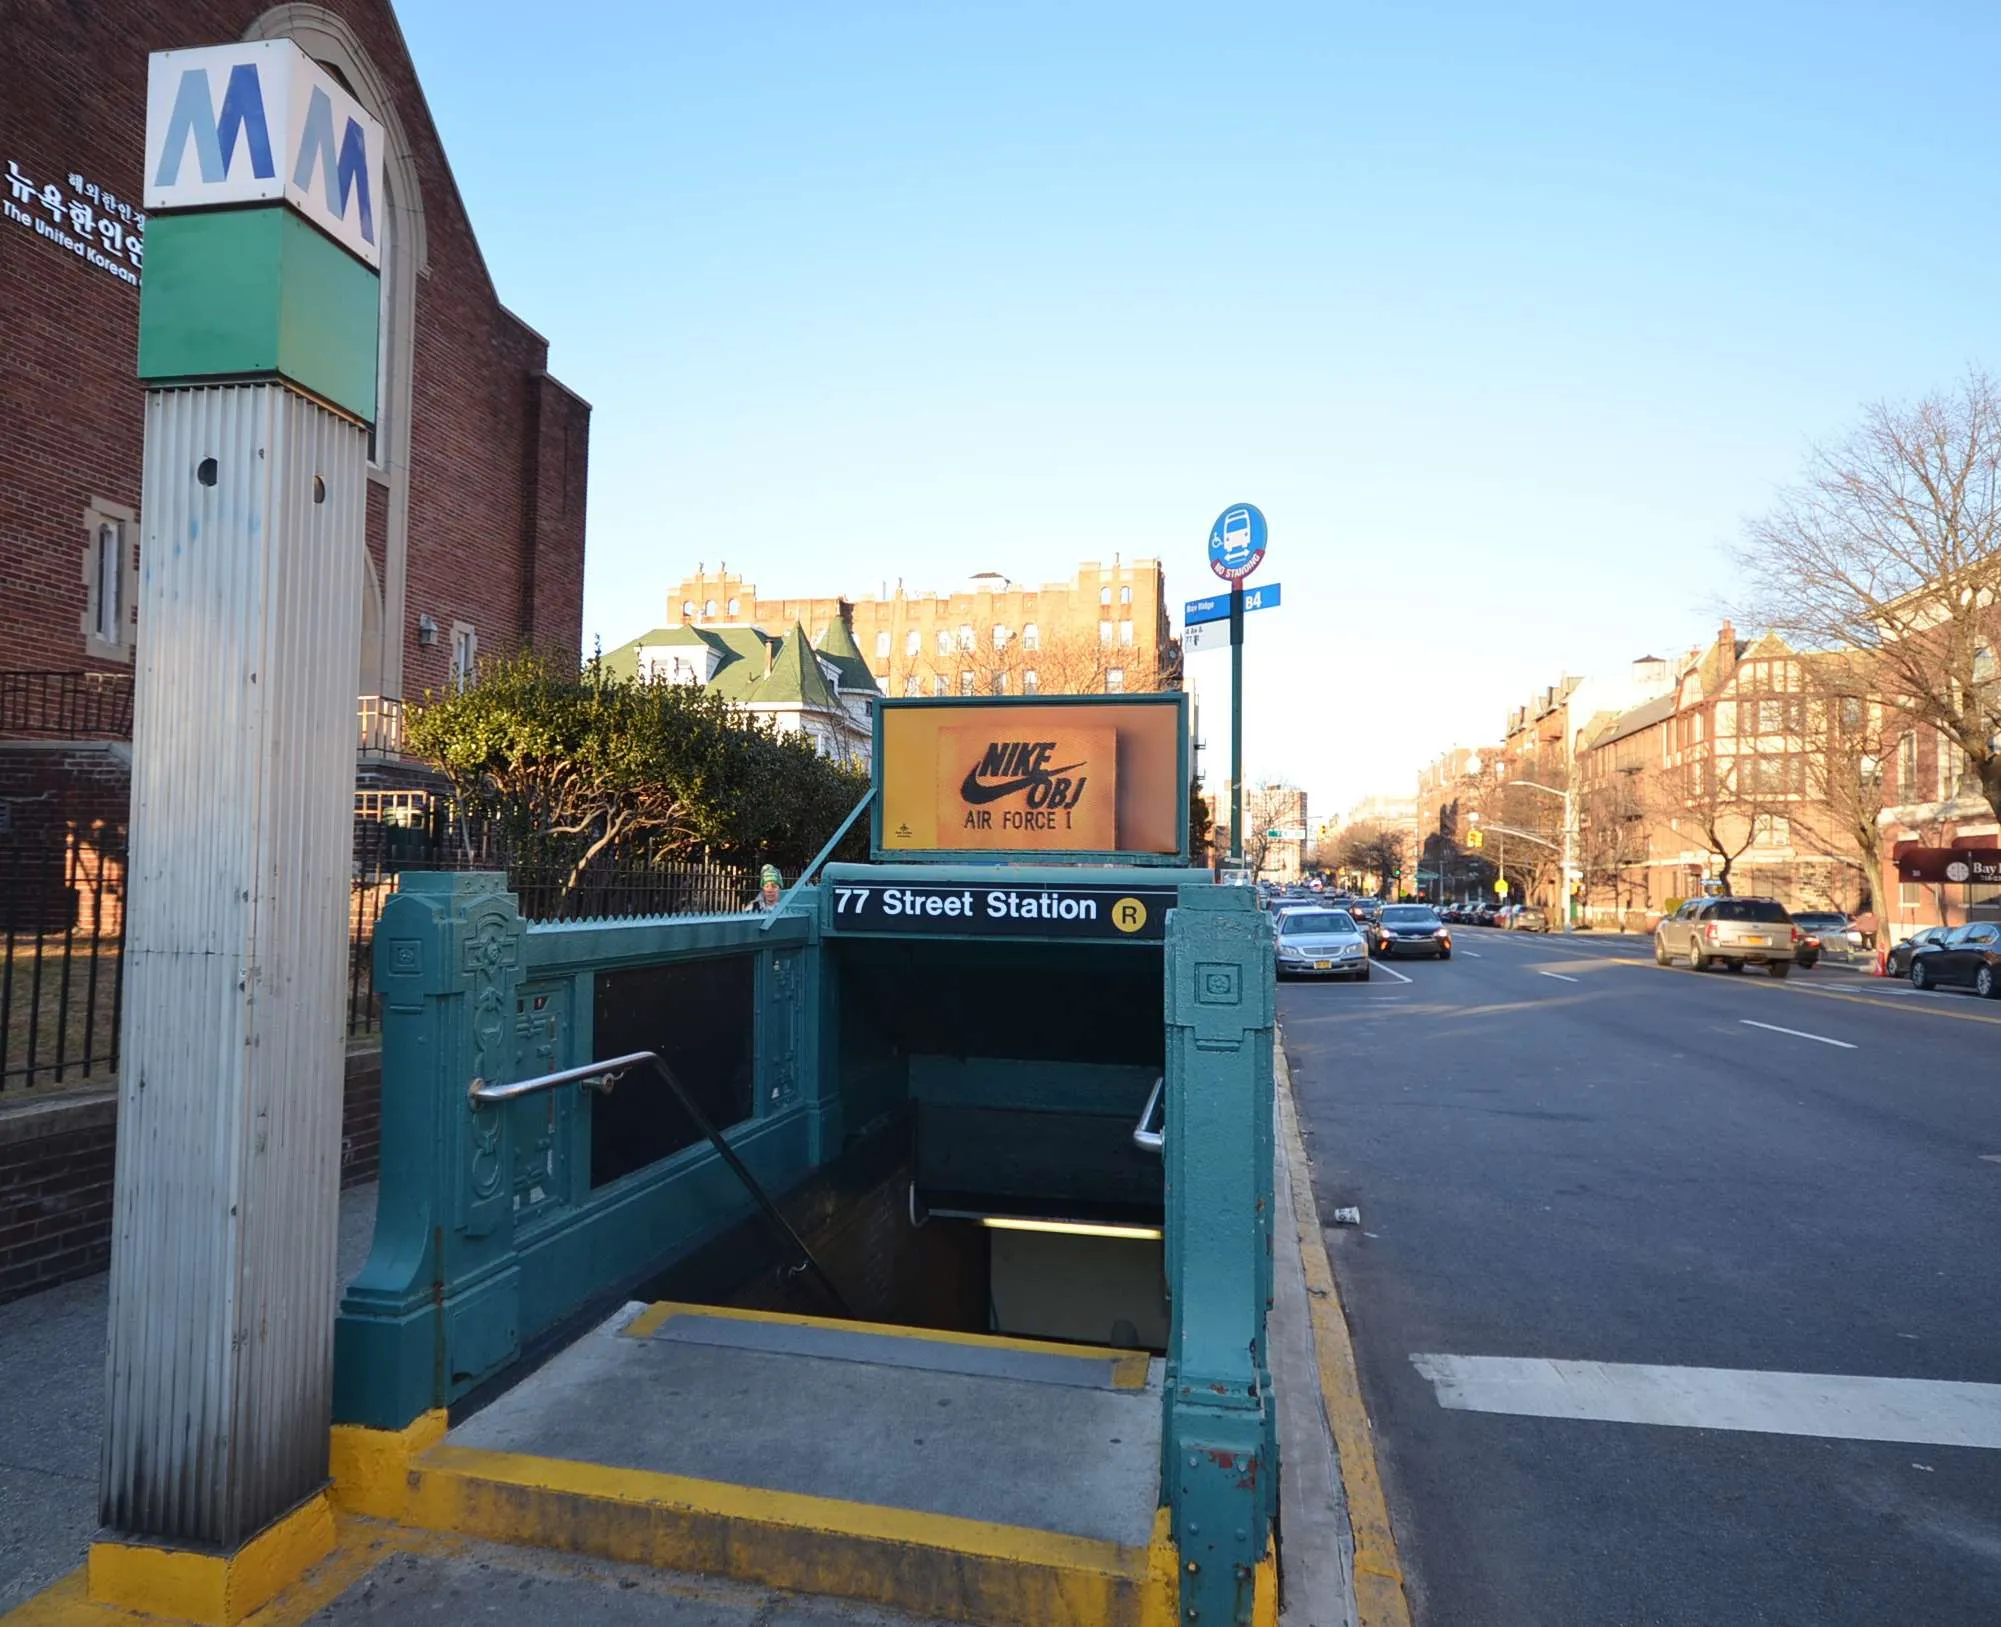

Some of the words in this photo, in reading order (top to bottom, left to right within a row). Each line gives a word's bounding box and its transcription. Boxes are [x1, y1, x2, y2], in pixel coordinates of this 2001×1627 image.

[3, 200, 32, 226] The
[35, 217, 85, 257] United
[87, 247, 137, 286] Korean
[1214, 562, 1226, 575] NO
[1225, 553, 1261, 578] STANDING
[1245, 591, 1262, 610] B4
[977, 742, 1056, 777] NIKE
[1026, 777, 1087, 810] OBJ
[964, 811, 992, 830] AIR
[1002, 811, 1056, 831] FORCE
[1973, 862, 1997, 876] Bay
[834, 888, 870, 914] 77
[882, 889, 974, 917] Street
[986, 891, 1097, 920] Station
[1121, 905, 1138, 925] R
